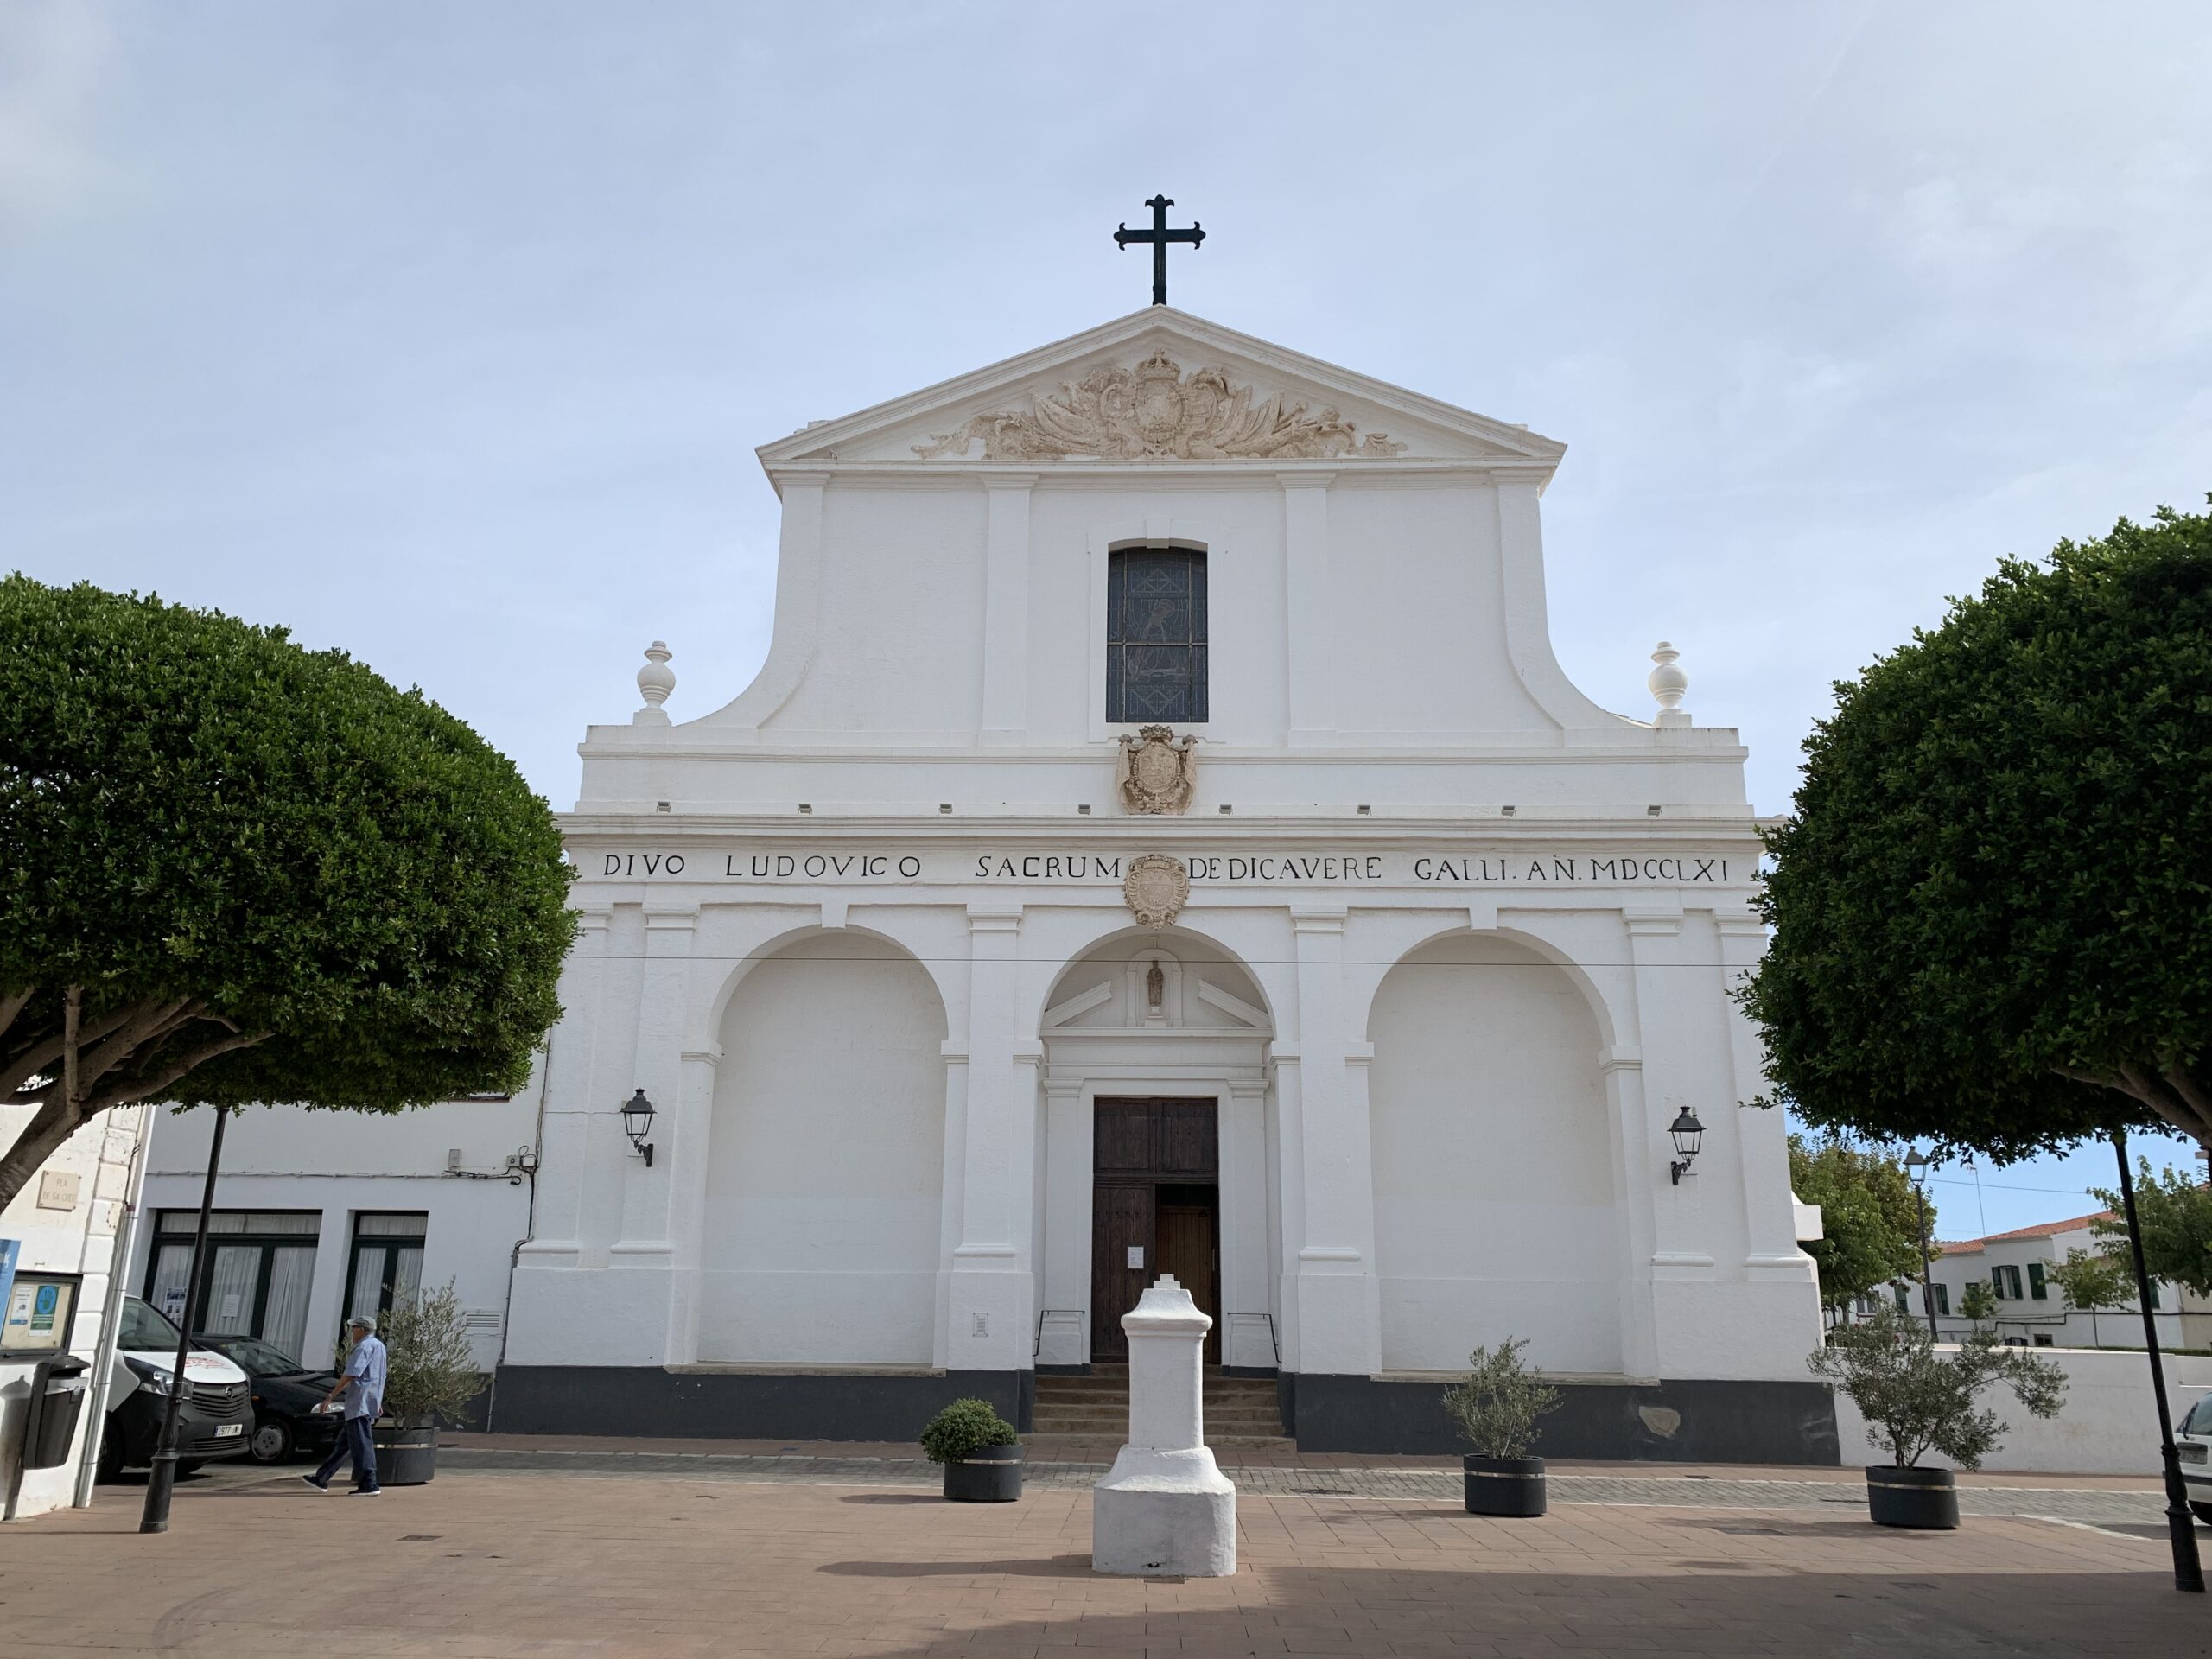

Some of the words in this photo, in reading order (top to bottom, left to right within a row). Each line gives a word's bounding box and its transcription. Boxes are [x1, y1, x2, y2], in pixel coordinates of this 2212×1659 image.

[604, 855, 685, 875] DIVO
[726, 855, 921, 878] LUDOVICO
[975, 856, 1122, 878] SACRUM
[1188, 857, 1382, 880] DEDICAVERE
[1590, 858, 1727, 881] MDCCLXI
